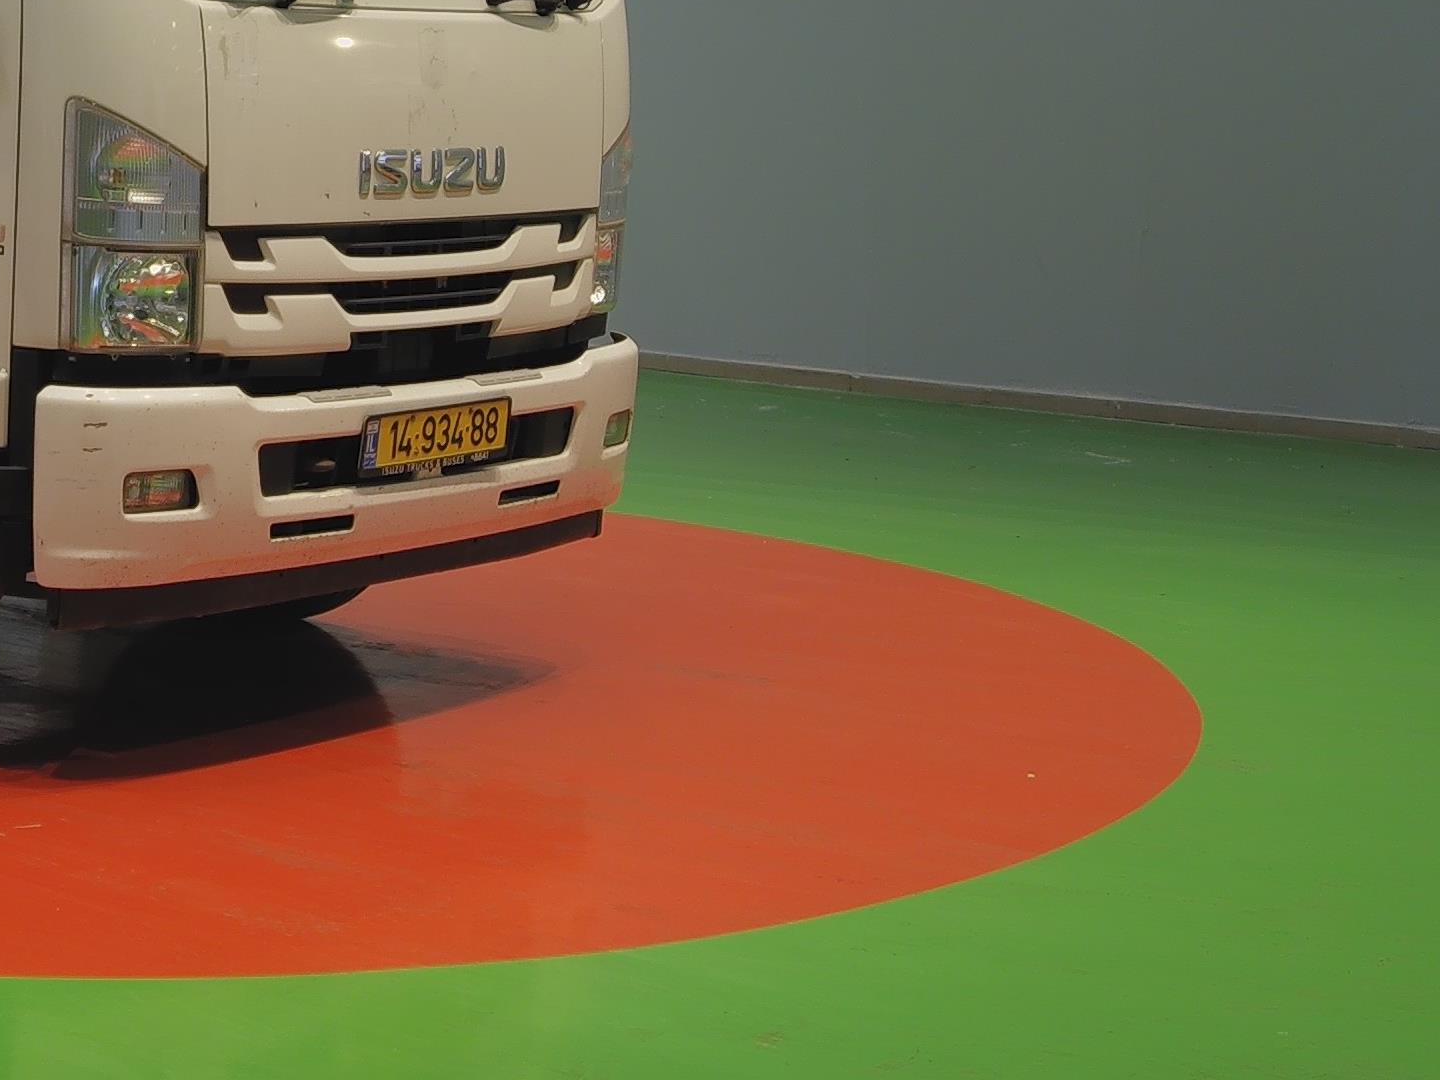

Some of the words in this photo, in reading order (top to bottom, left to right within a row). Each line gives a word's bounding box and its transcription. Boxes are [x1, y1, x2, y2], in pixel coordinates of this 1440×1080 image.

[358, 145, 506, 199] ISUZU
[381, 464, 405, 477] ISUZU
[406, 460, 434, 473] TRUCKS
[442, 454, 465, 468] BUSES
